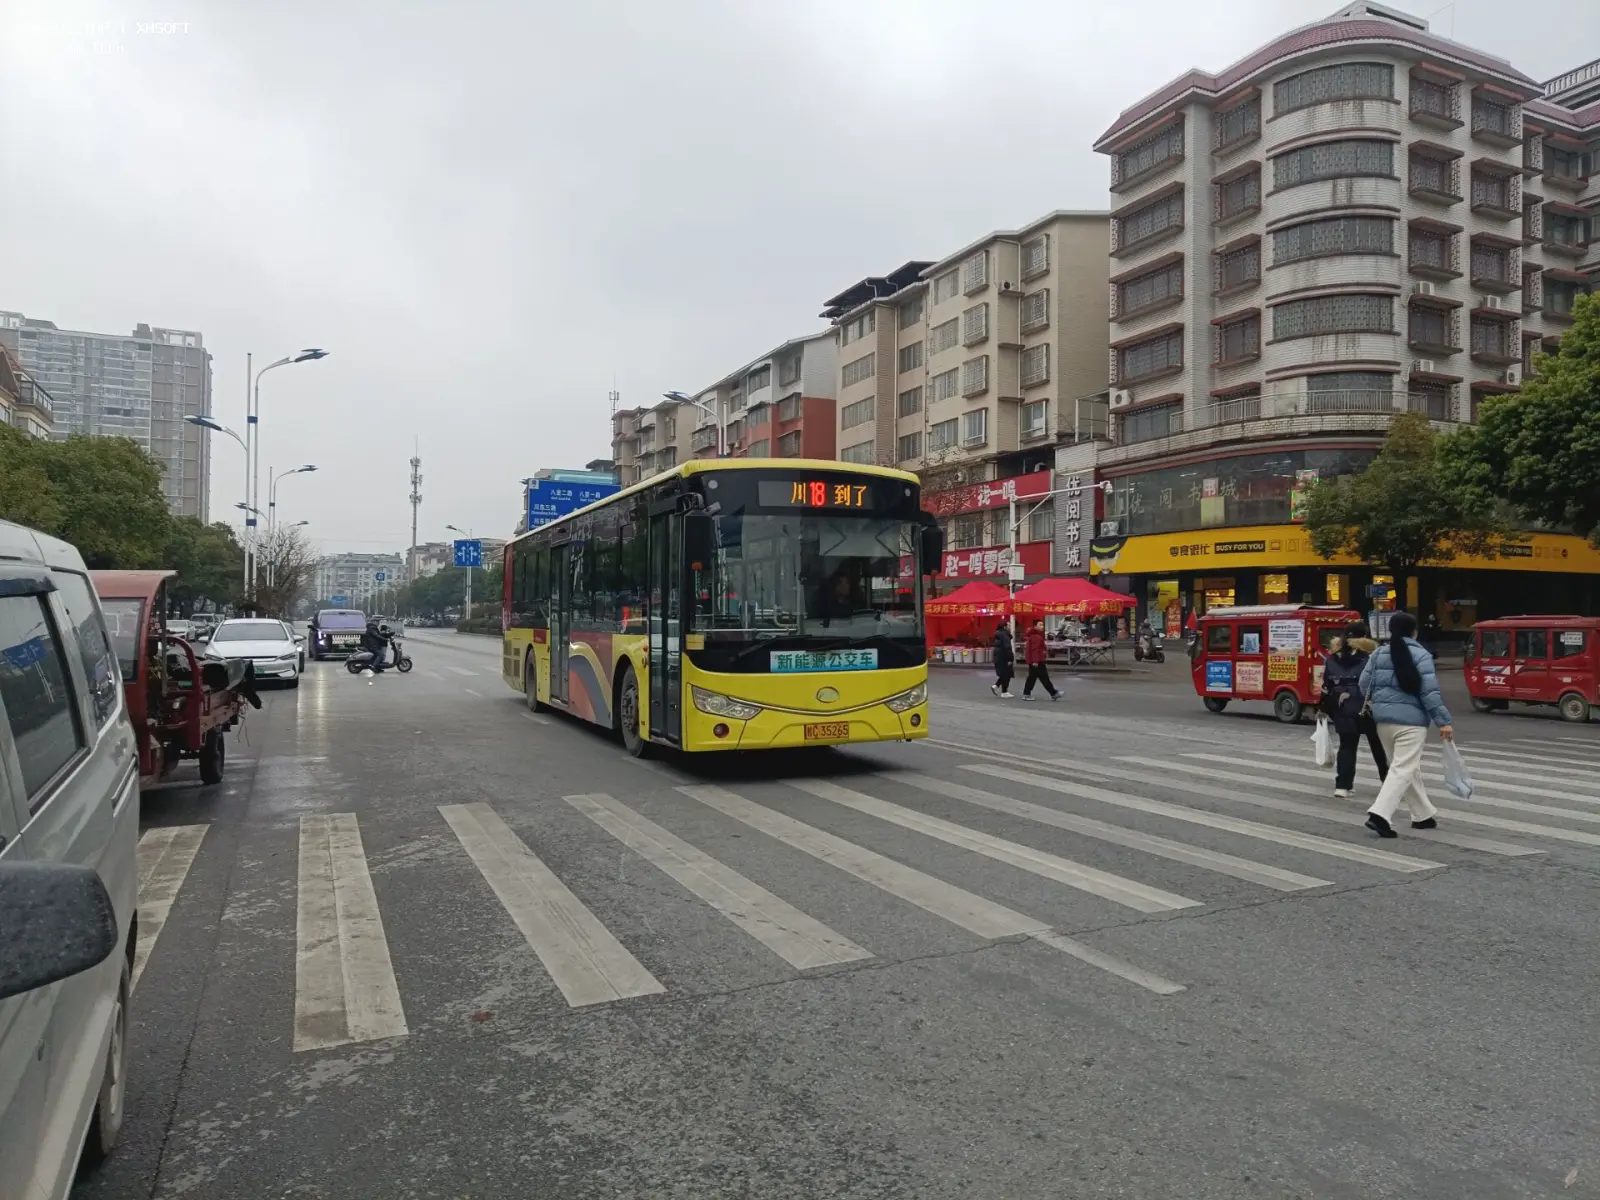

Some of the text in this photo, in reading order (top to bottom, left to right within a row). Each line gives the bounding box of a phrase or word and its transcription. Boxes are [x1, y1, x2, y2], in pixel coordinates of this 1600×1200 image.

[834, 484, 868, 507] 到了
[1066, 476, 1081, 568] 优阅书城
[1216, 543, 1264, 552] BUSY FOR YOU
[777, 651, 873, 670] 新能源公交车
